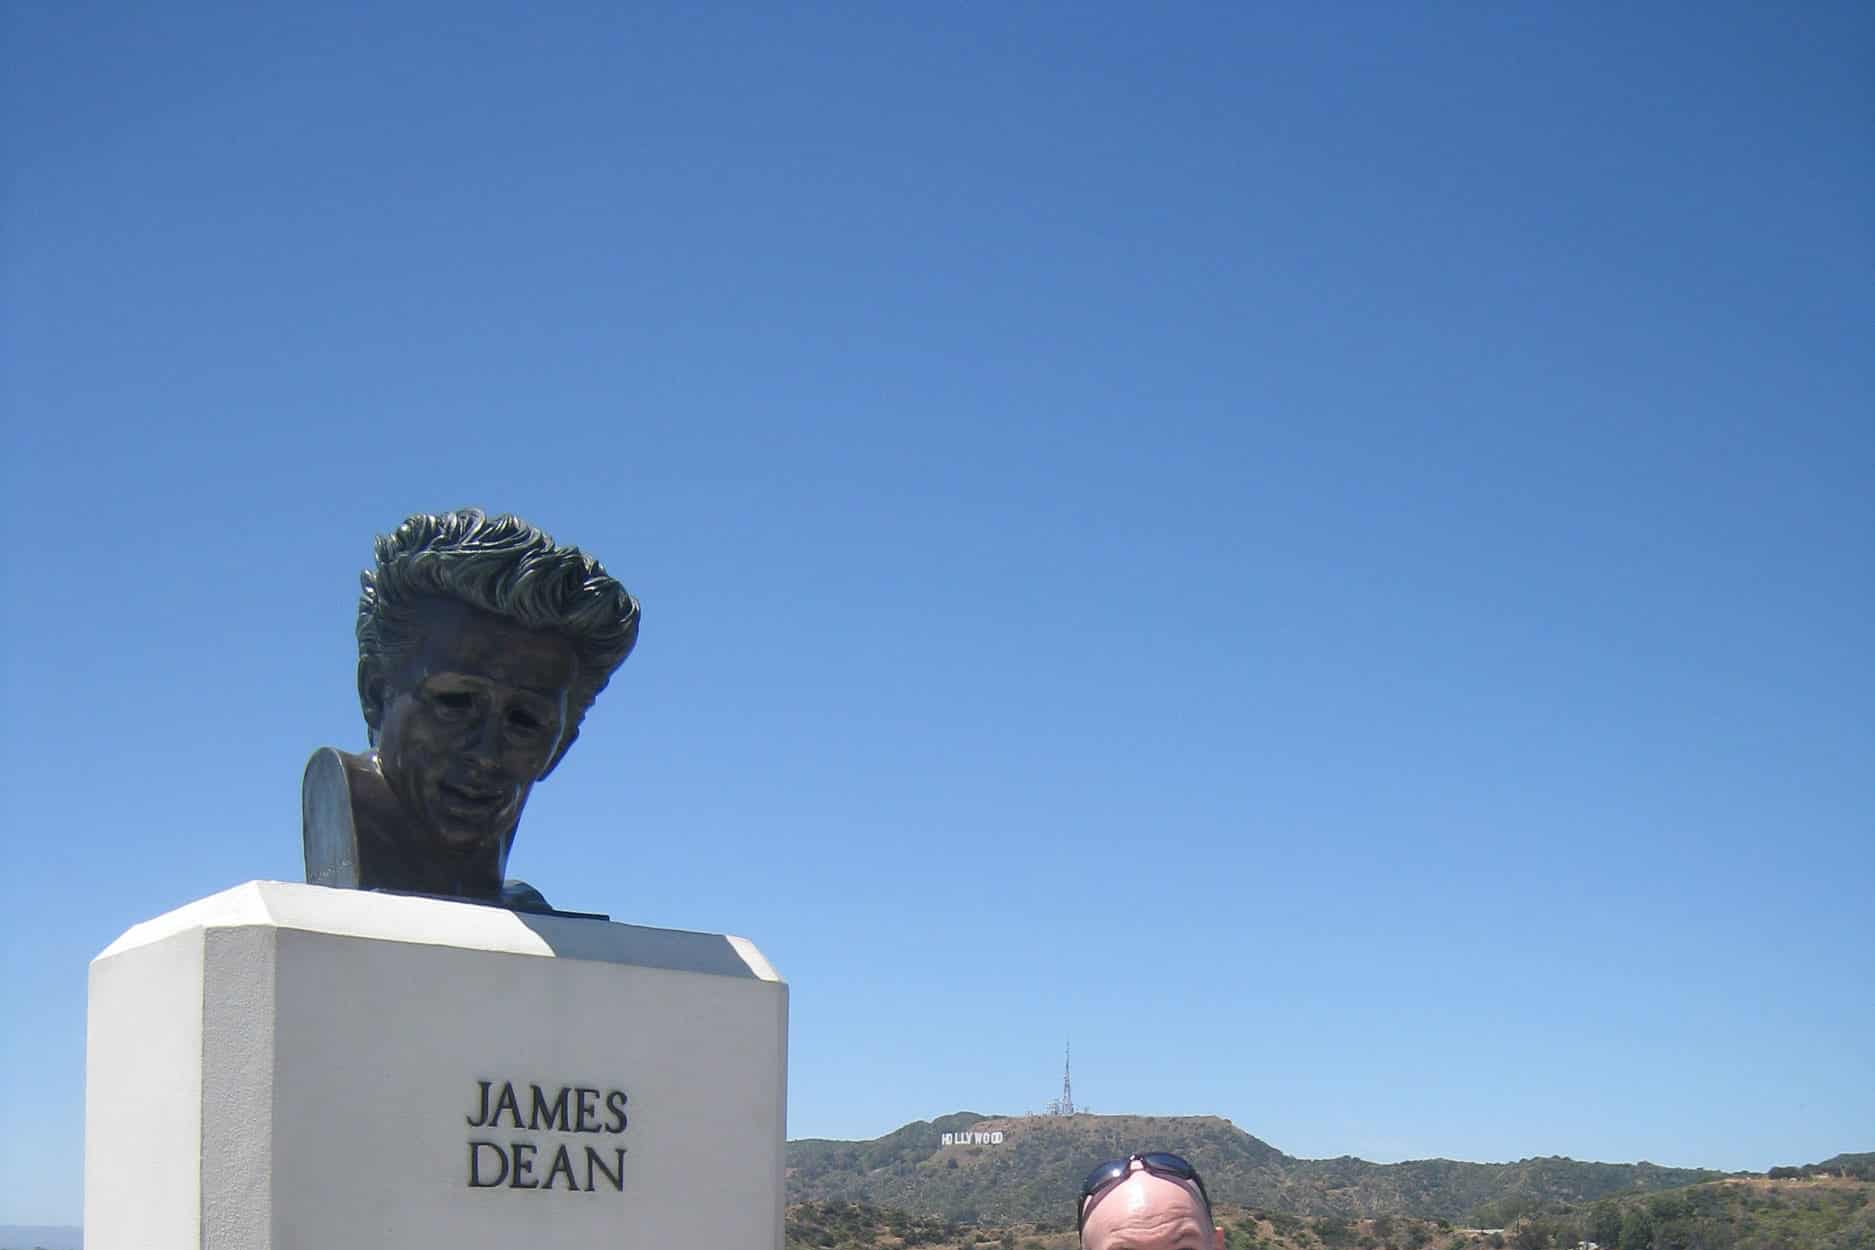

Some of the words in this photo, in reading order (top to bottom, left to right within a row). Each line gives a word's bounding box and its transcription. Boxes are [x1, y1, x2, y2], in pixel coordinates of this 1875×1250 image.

[466, 1079, 628, 1134] JAMES
[942, 1131, 1003, 1145] HOLLYWOOD
[467, 1141, 628, 1192] DEAN
